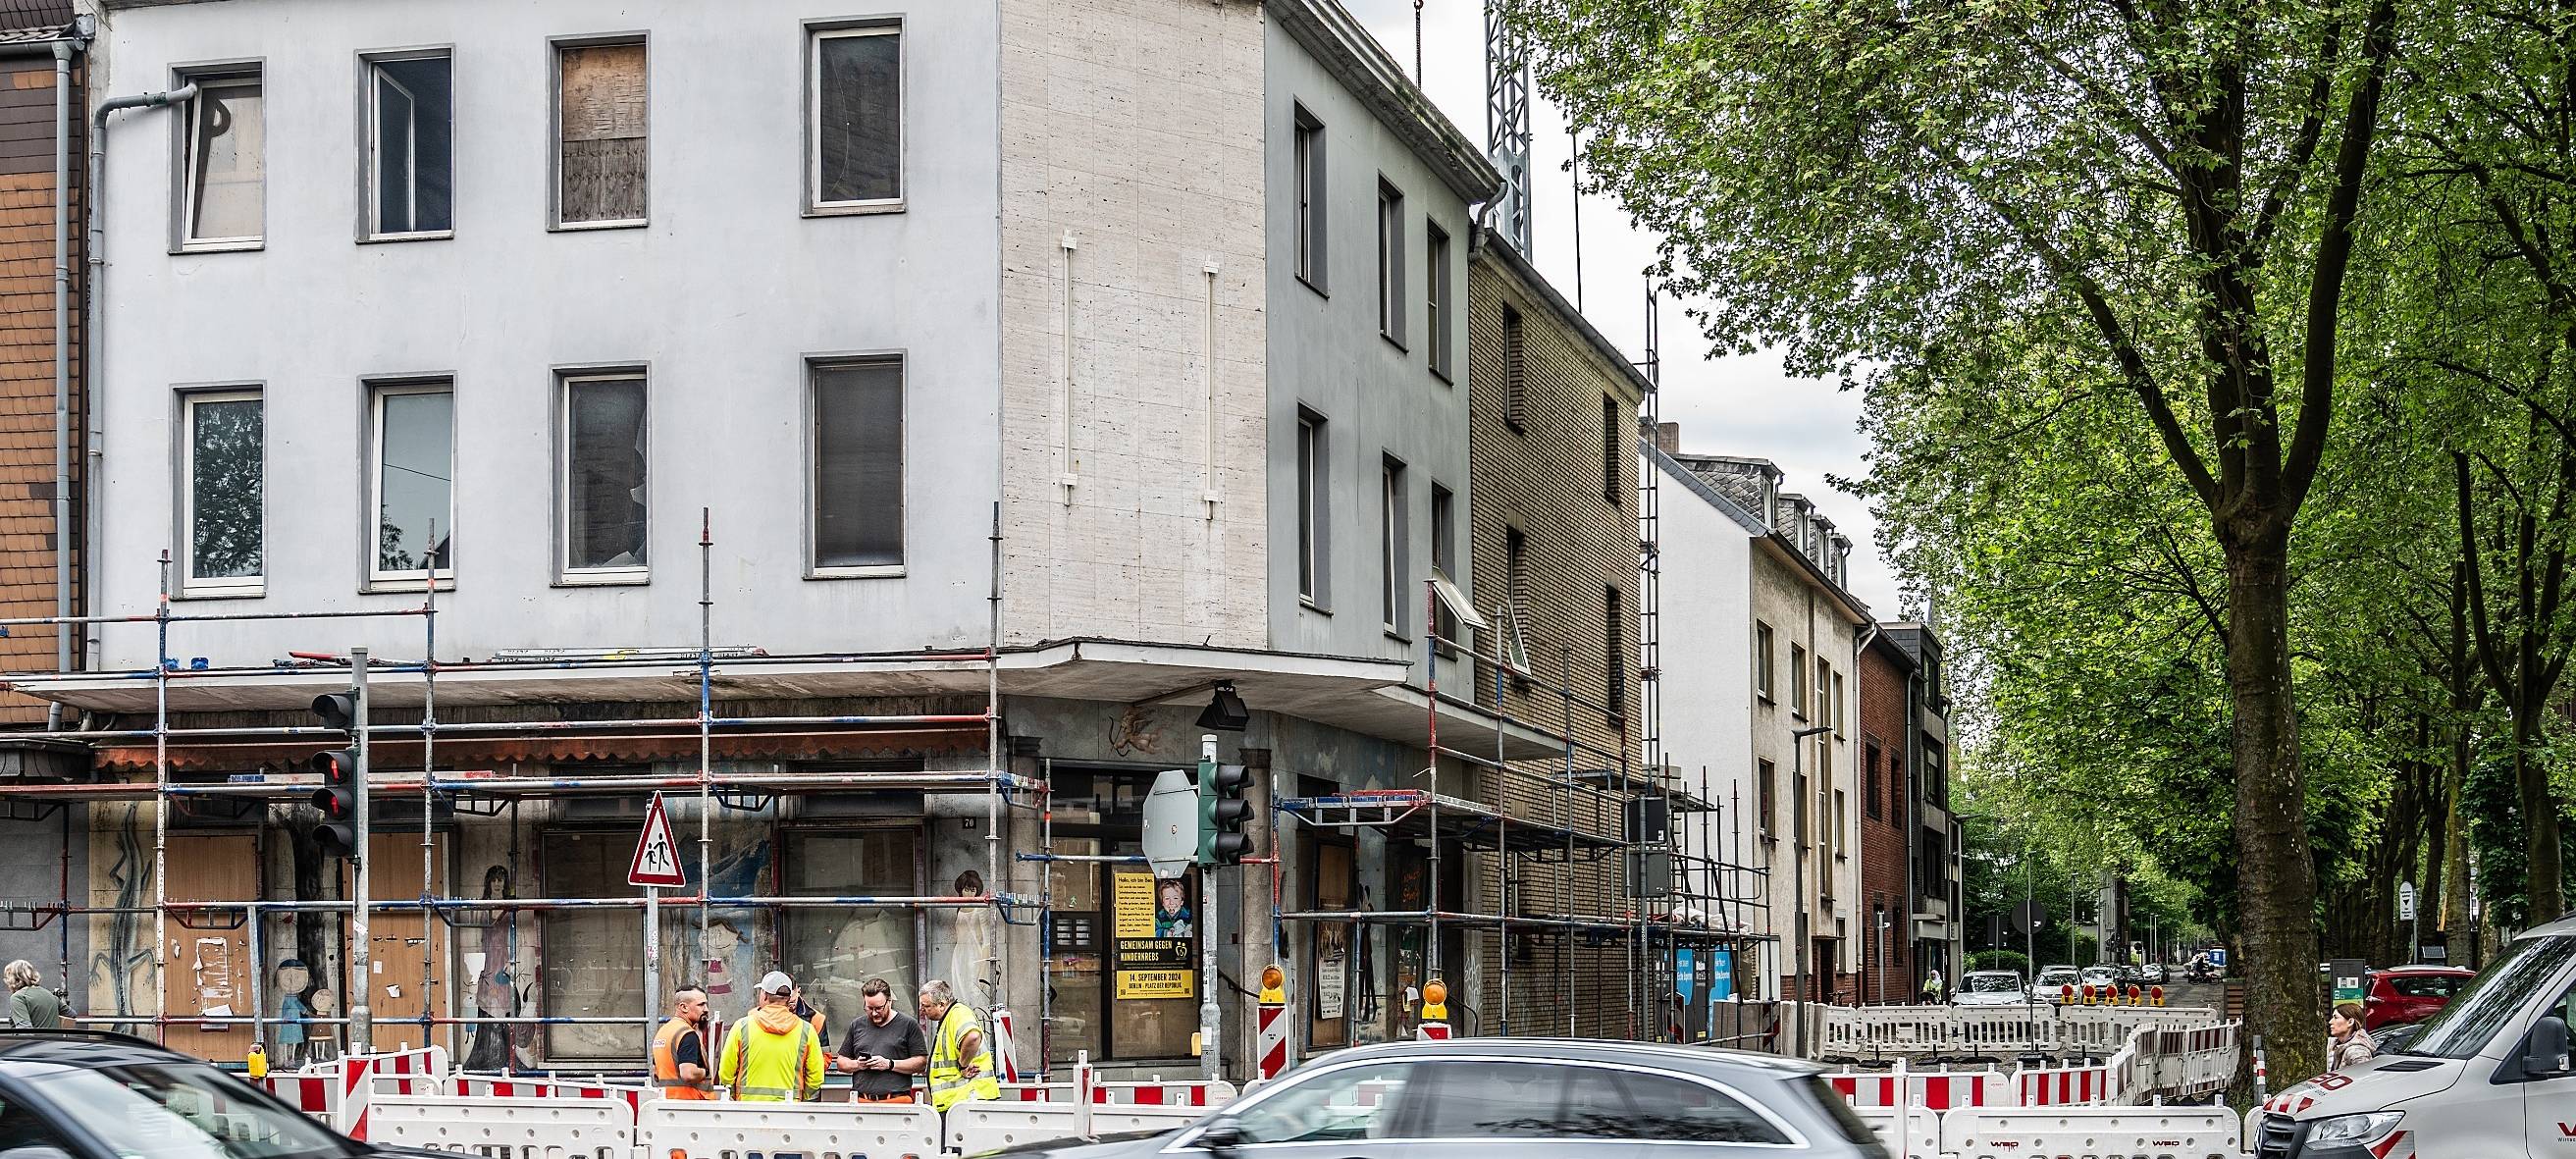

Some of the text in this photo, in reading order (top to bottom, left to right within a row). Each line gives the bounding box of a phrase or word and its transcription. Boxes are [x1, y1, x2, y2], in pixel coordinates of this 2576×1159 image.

[1120, 940, 1173, 950] GEMEINSAM GEGEN
[1120, 952, 1159, 962] KINDERKREBS
[1137, 973, 1168, 981] SEPTEMBER
[1168, 973, 1182, 981] 2024
